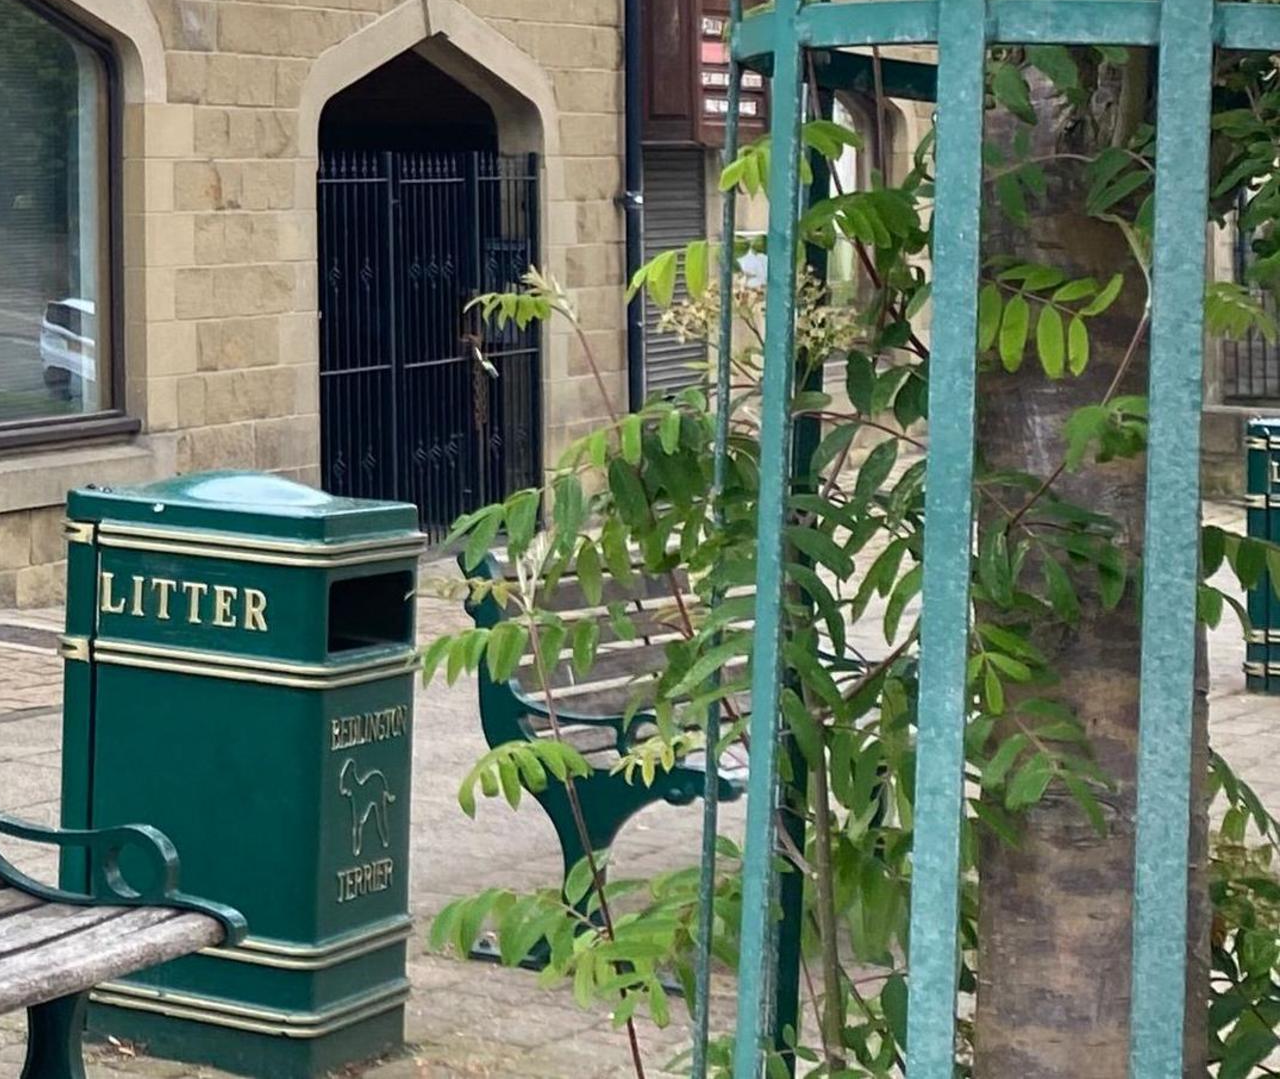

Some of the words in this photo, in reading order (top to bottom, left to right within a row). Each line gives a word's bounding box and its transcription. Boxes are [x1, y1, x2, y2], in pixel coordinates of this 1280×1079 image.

[101, 572, 268, 632] LITTER
[331, 704, 408, 751] BEDLINGTON
[337, 858, 393, 903] TERRIER
